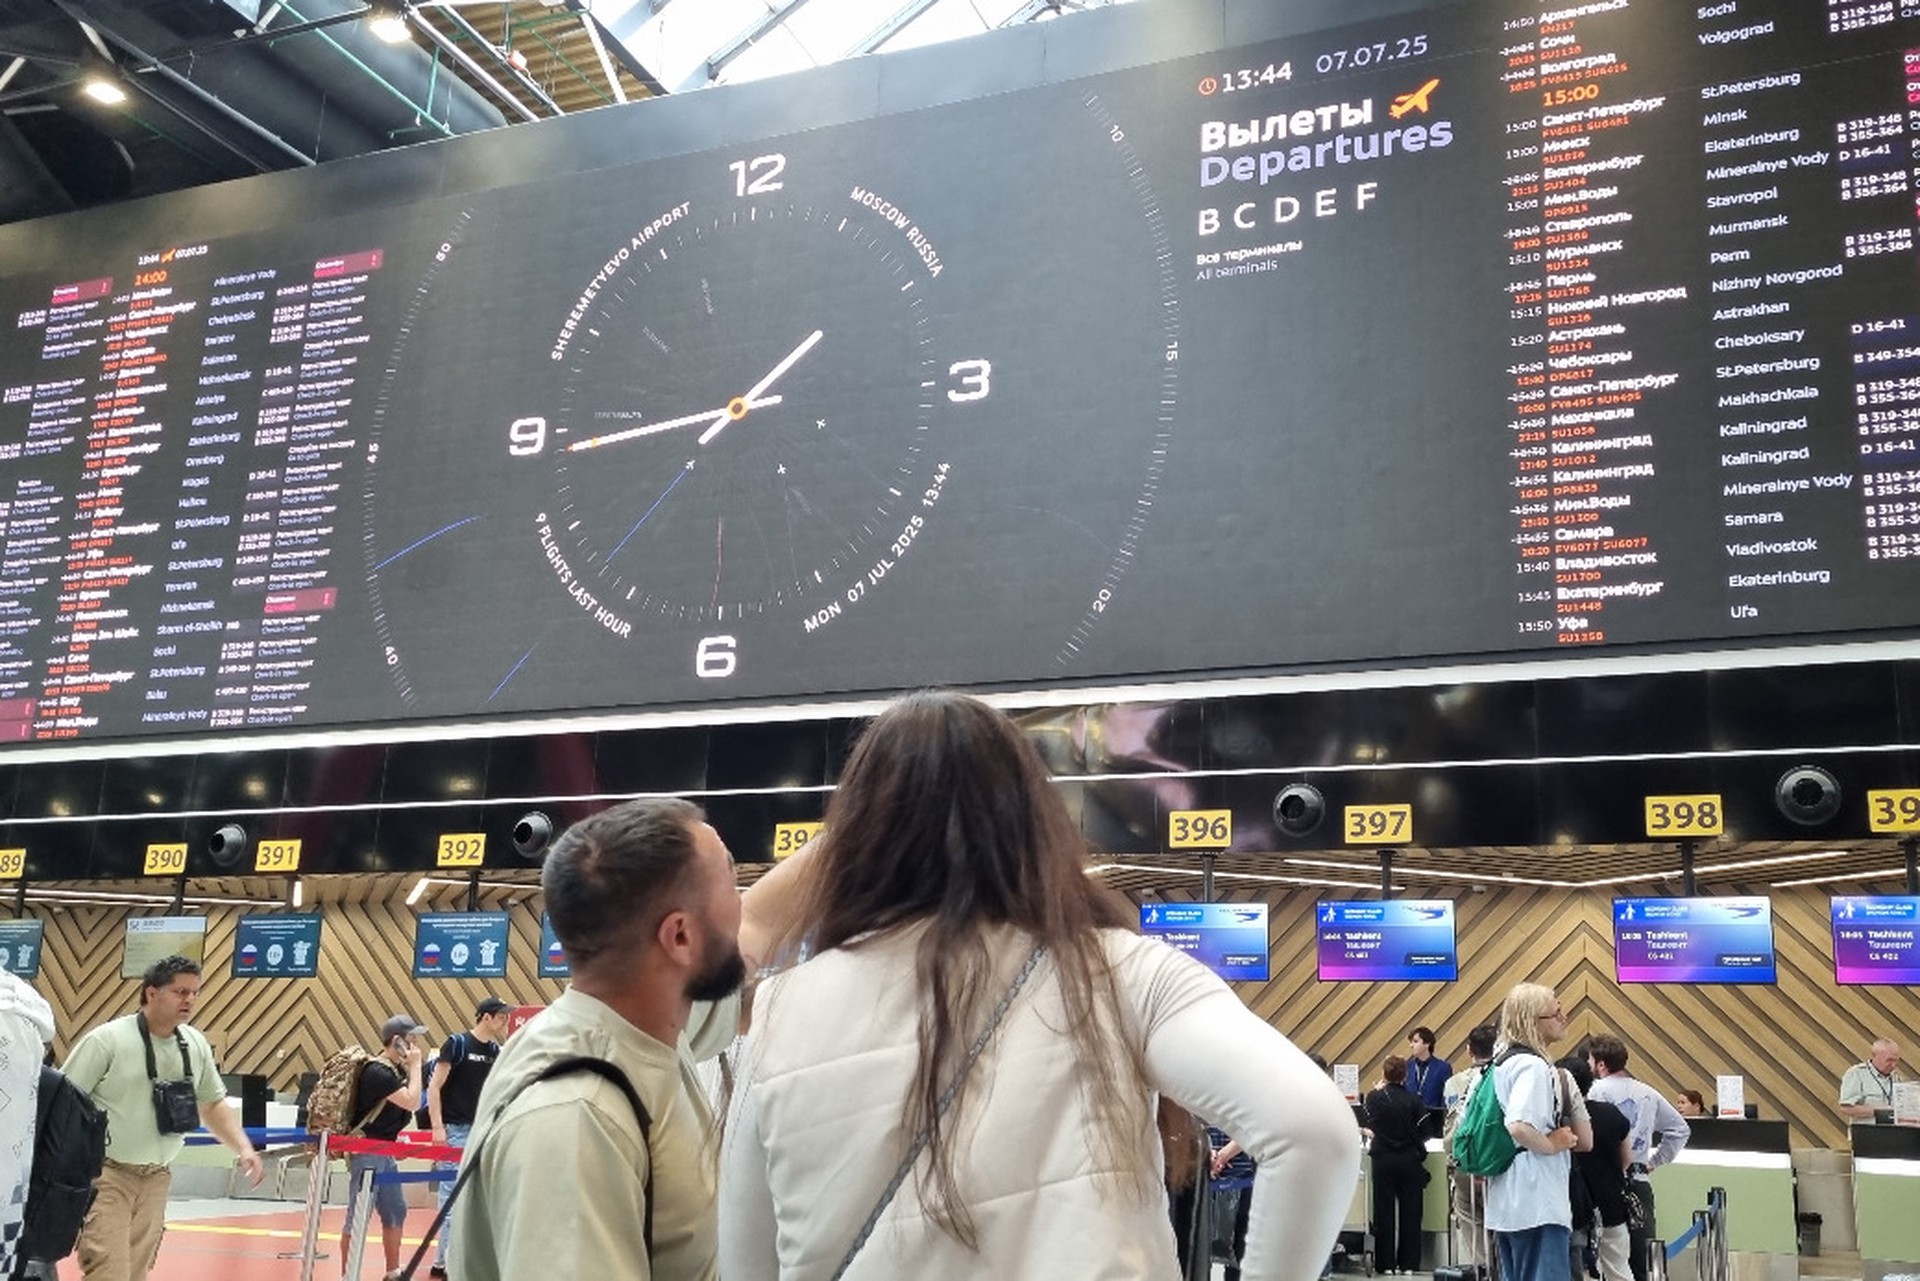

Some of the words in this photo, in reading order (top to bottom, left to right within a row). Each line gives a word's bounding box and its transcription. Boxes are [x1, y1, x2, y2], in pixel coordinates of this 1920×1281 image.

[1697, 1, 1737, 19] Sochi
[1539, 34, 1576, 49] Сочи
[1698, 21, 1774, 45] Volgograd
[1222, 61, 1293, 93] 13:44
[1316, 34, 1428, 74] 07.07.25
[1540, 53, 1617, 75] Волгоград
[1543, 84, 1600, 107] 15:00
[1701, 72, 1801, 99] St.Petersburg
[1542, 96, 1666, 127] Санкт-Петербург
[1703, 108, 1748, 126] Minsk
[1108, 124, 1125, 143] 10
[1200, 98, 1373, 152] Вылеты
[1543, 136, 1590, 153] Минск
[1704, 128, 1800, 154] Ekaterinburg
[1839, 151, 1851, 161] D
[1853, 143, 1891, 158] 16-41
[1200, 120, 1453, 188] Departures
[1706, 158, 1788, 180] Mineralnye
[1791, 150, 1830, 167] Vody
[729, 153, 786, 197] 12
[1706, 186, 1778, 209] Stavropol
[1198, 207, 1220, 236] B
[1233, 202, 1256, 229] C
[1274, 197, 1300, 223] D
[1315, 188, 1337, 217] E
[1357, 182, 1378, 210] F
[849, 186, 911, 229] MOSCOW
[906, 226, 944, 278] RUSSIA
[1545, 211, 1633, 233] Ставрополь
[1708, 214, 1789, 236] Murmansk
[1224, 240, 1303, 262] терминалы
[1509, 253, 1541, 266] 15:10
[1546, 239, 1623, 261] Мурманск
[1710, 249, 1751, 264] Perm
[551, 248, 629, 361] SHEREMETYEVO
[630, 201, 691, 250] AIRPORT
[1546, 271, 1597, 288] Пермь
[1712, 275, 1762, 293] Nizhny
[1766, 264, 1843, 284] Novgorod
[1548, 295, 1609, 315] Нижний
[1611, 286, 1688, 306] Новгород
[1713, 301, 1790, 321] Astrakhan
[1510, 306, 1542, 319] 15:15
[1548, 323, 1627, 342] Астрахань
[1851, 324, 1863, 334] D
[1866, 318, 1906, 332] 16-41
[1511, 334, 1544, 347] 15:20
[1714, 328, 1806, 350] Cheboksary
[1165, 340, 1179, 362] 15
[1548, 351, 1632, 369] Чебоксары
[1716, 356, 1821, 378] St.Petersburg
[947, 358, 992, 402] 3
[1550, 373, 1679, 398] Санкт-Петербург
[1718, 385, 1820, 408] Makhachkala
[1551, 408, 1635, 426] Махачкала
[1719, 416, 1808, 437] Kaliningrad
[509, 416, 546, 456] 9
[1552, 434, 1653, 454] Калининград
[1861, 444, 1873, 454] D
[1876, 439, 1916, 454] 16-41
[1721, 446, 1811, 467] Kaliningrad
[1553, 463, 1655, 484] Калининград
[1723, 478, 1811, 496] Mineralnye
[1813, 473, 1853, 489] Vody
[1554, 495, 1631, 512] Мин.Воды
[1725, 511, 1785, 526] Samara
[1555, 526, 1615, 542] Самара
[803, 601, 842, 633] MON
[847, 580, 866, 602] 07
[868, 559, 895, 585] JUL
[891, 515, 924, 557] 2025
[922, 462, 951, 507] 13:44
[1726, 537, 1818, 557] Vladivostok
[1516, 561, 1551, 574] 15:40
[1556, 552, 1658, 570] Владивосток
[538, 524, 573, 583] FLIGHTS
[568, 580, 598, 611] LAST
[594, 605, 632, 639] HOUR
[1728, 569, 1831, 587] Ekaterinburg
[1092, 588, 1112, 612] 20
[1518, 591, 1551, 603] 15:45
[1556, 581, 1664, 600] Екатеринбург
[1730, 604, 1759, 618] Ufa
[1518, 621, 1553, 634] 15:50
[1557, 617, 1589, 631] Уфа
[384, 645, 399, 665] 40
[695, 635, 738, 678] 6
[1651, 801, 1719, 830] 398
[1875, 796, 1920, 826] 39
[1174, 816, 1228, 842] 396
[1350, 810, 1408, 837] 397
[148, 849, 183, 870] 390
[260, 845, 295, 866] 391
[441, 837, 482, 861] 392
[0, 855, 21, 874] 89
